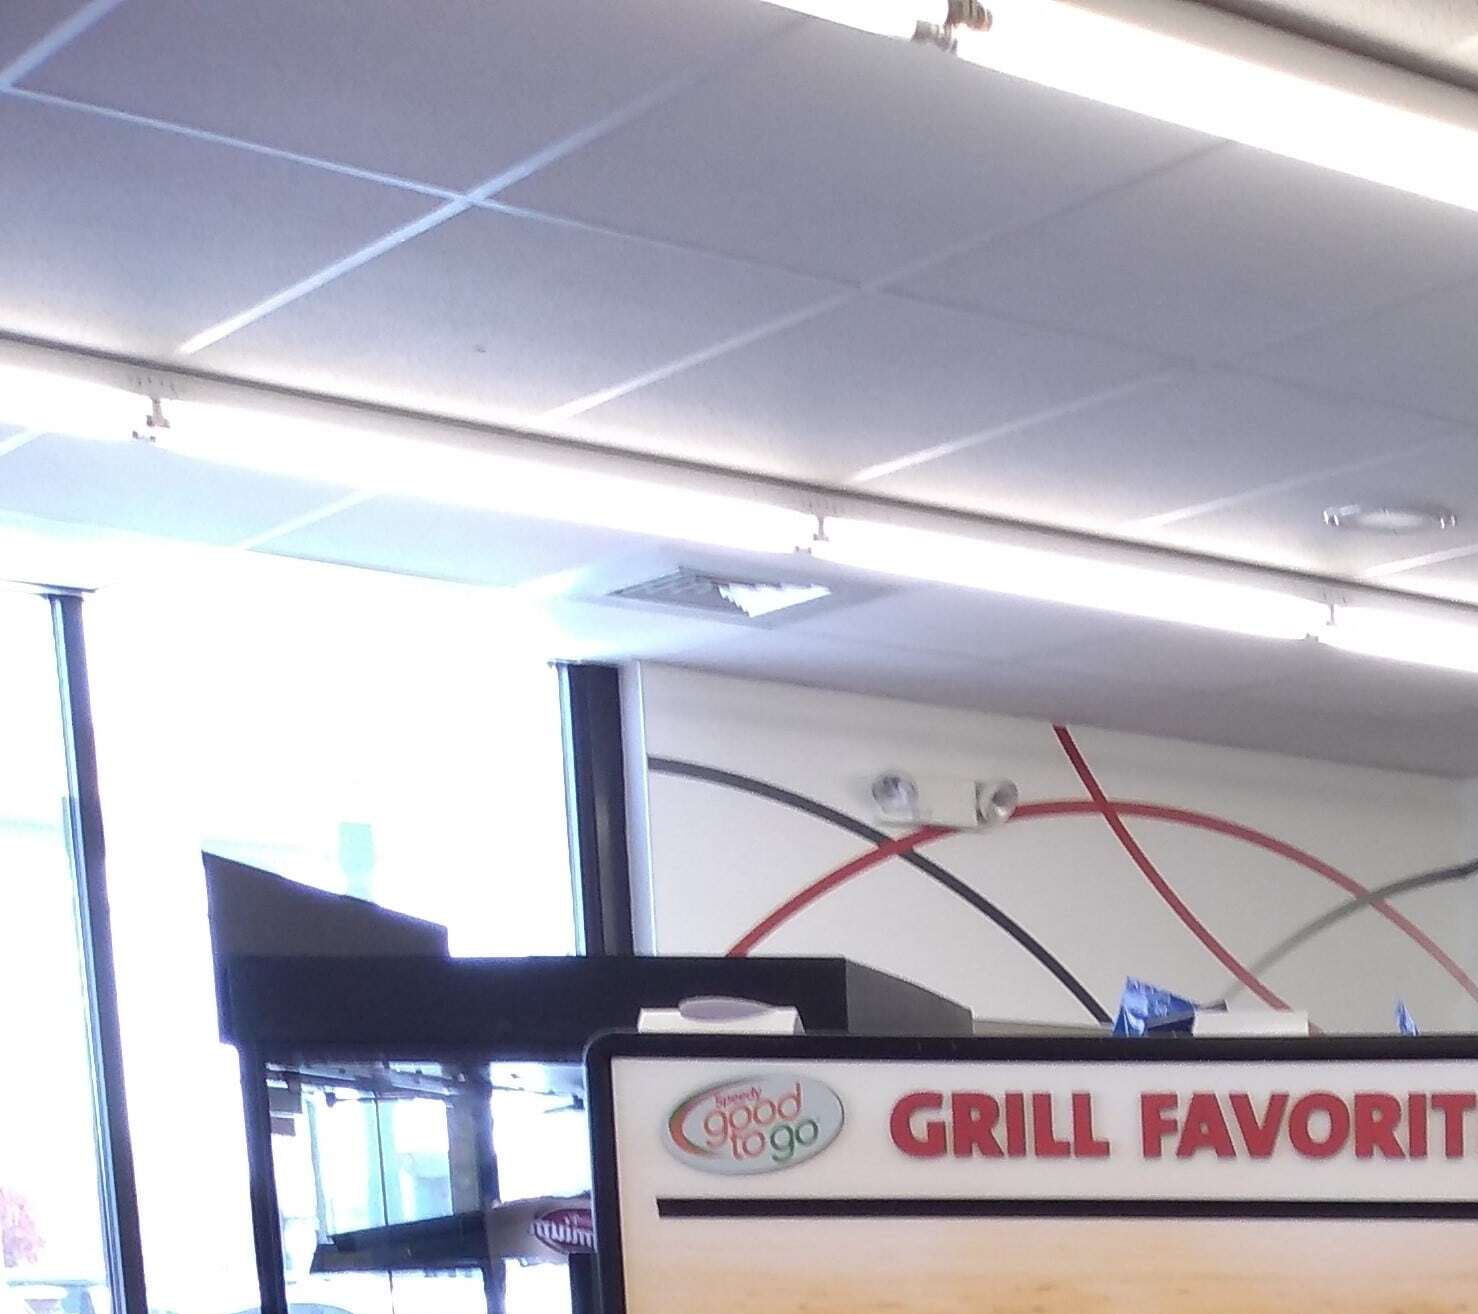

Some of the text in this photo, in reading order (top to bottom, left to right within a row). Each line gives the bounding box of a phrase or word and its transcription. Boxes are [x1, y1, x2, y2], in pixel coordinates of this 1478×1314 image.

[703, 1081, 801, 1148] good
[730, 1118, 819, 1162] to go
[889, 1090, 1110, 1159] GRILL
